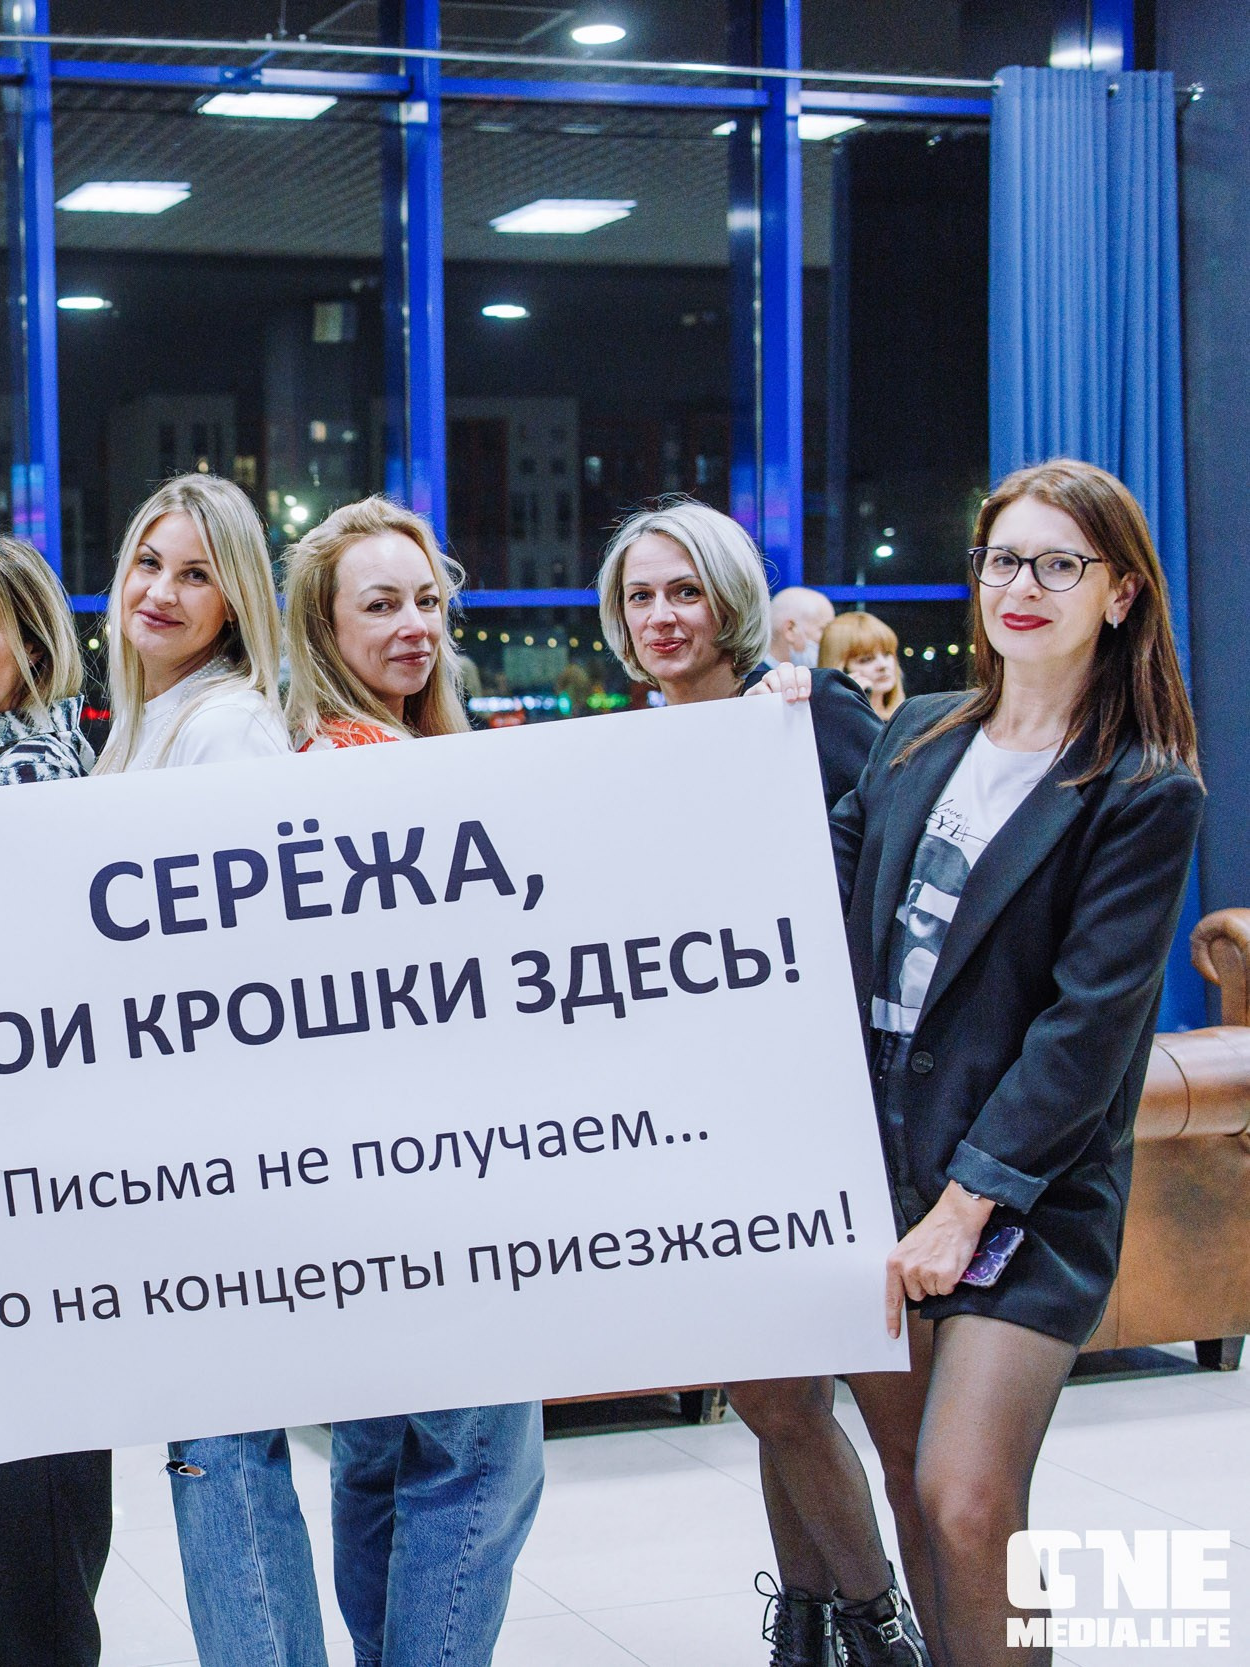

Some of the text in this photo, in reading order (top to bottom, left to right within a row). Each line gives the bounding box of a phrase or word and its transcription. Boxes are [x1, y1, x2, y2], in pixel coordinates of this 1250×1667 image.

[89, 818, 544, 942] СЕРЁЖА,
[123, 957, 487, 1059] КРОШКИ
[510, 917, 800, 1025] ЗДЕСЬ!
[3, 1110, 709, 1218] Письма не получаем...
[52, 1283, 121, 1324] на
[142, 1250, 445, 1315] концерты
[468, 1190, 856, 1292] приезжаем!
